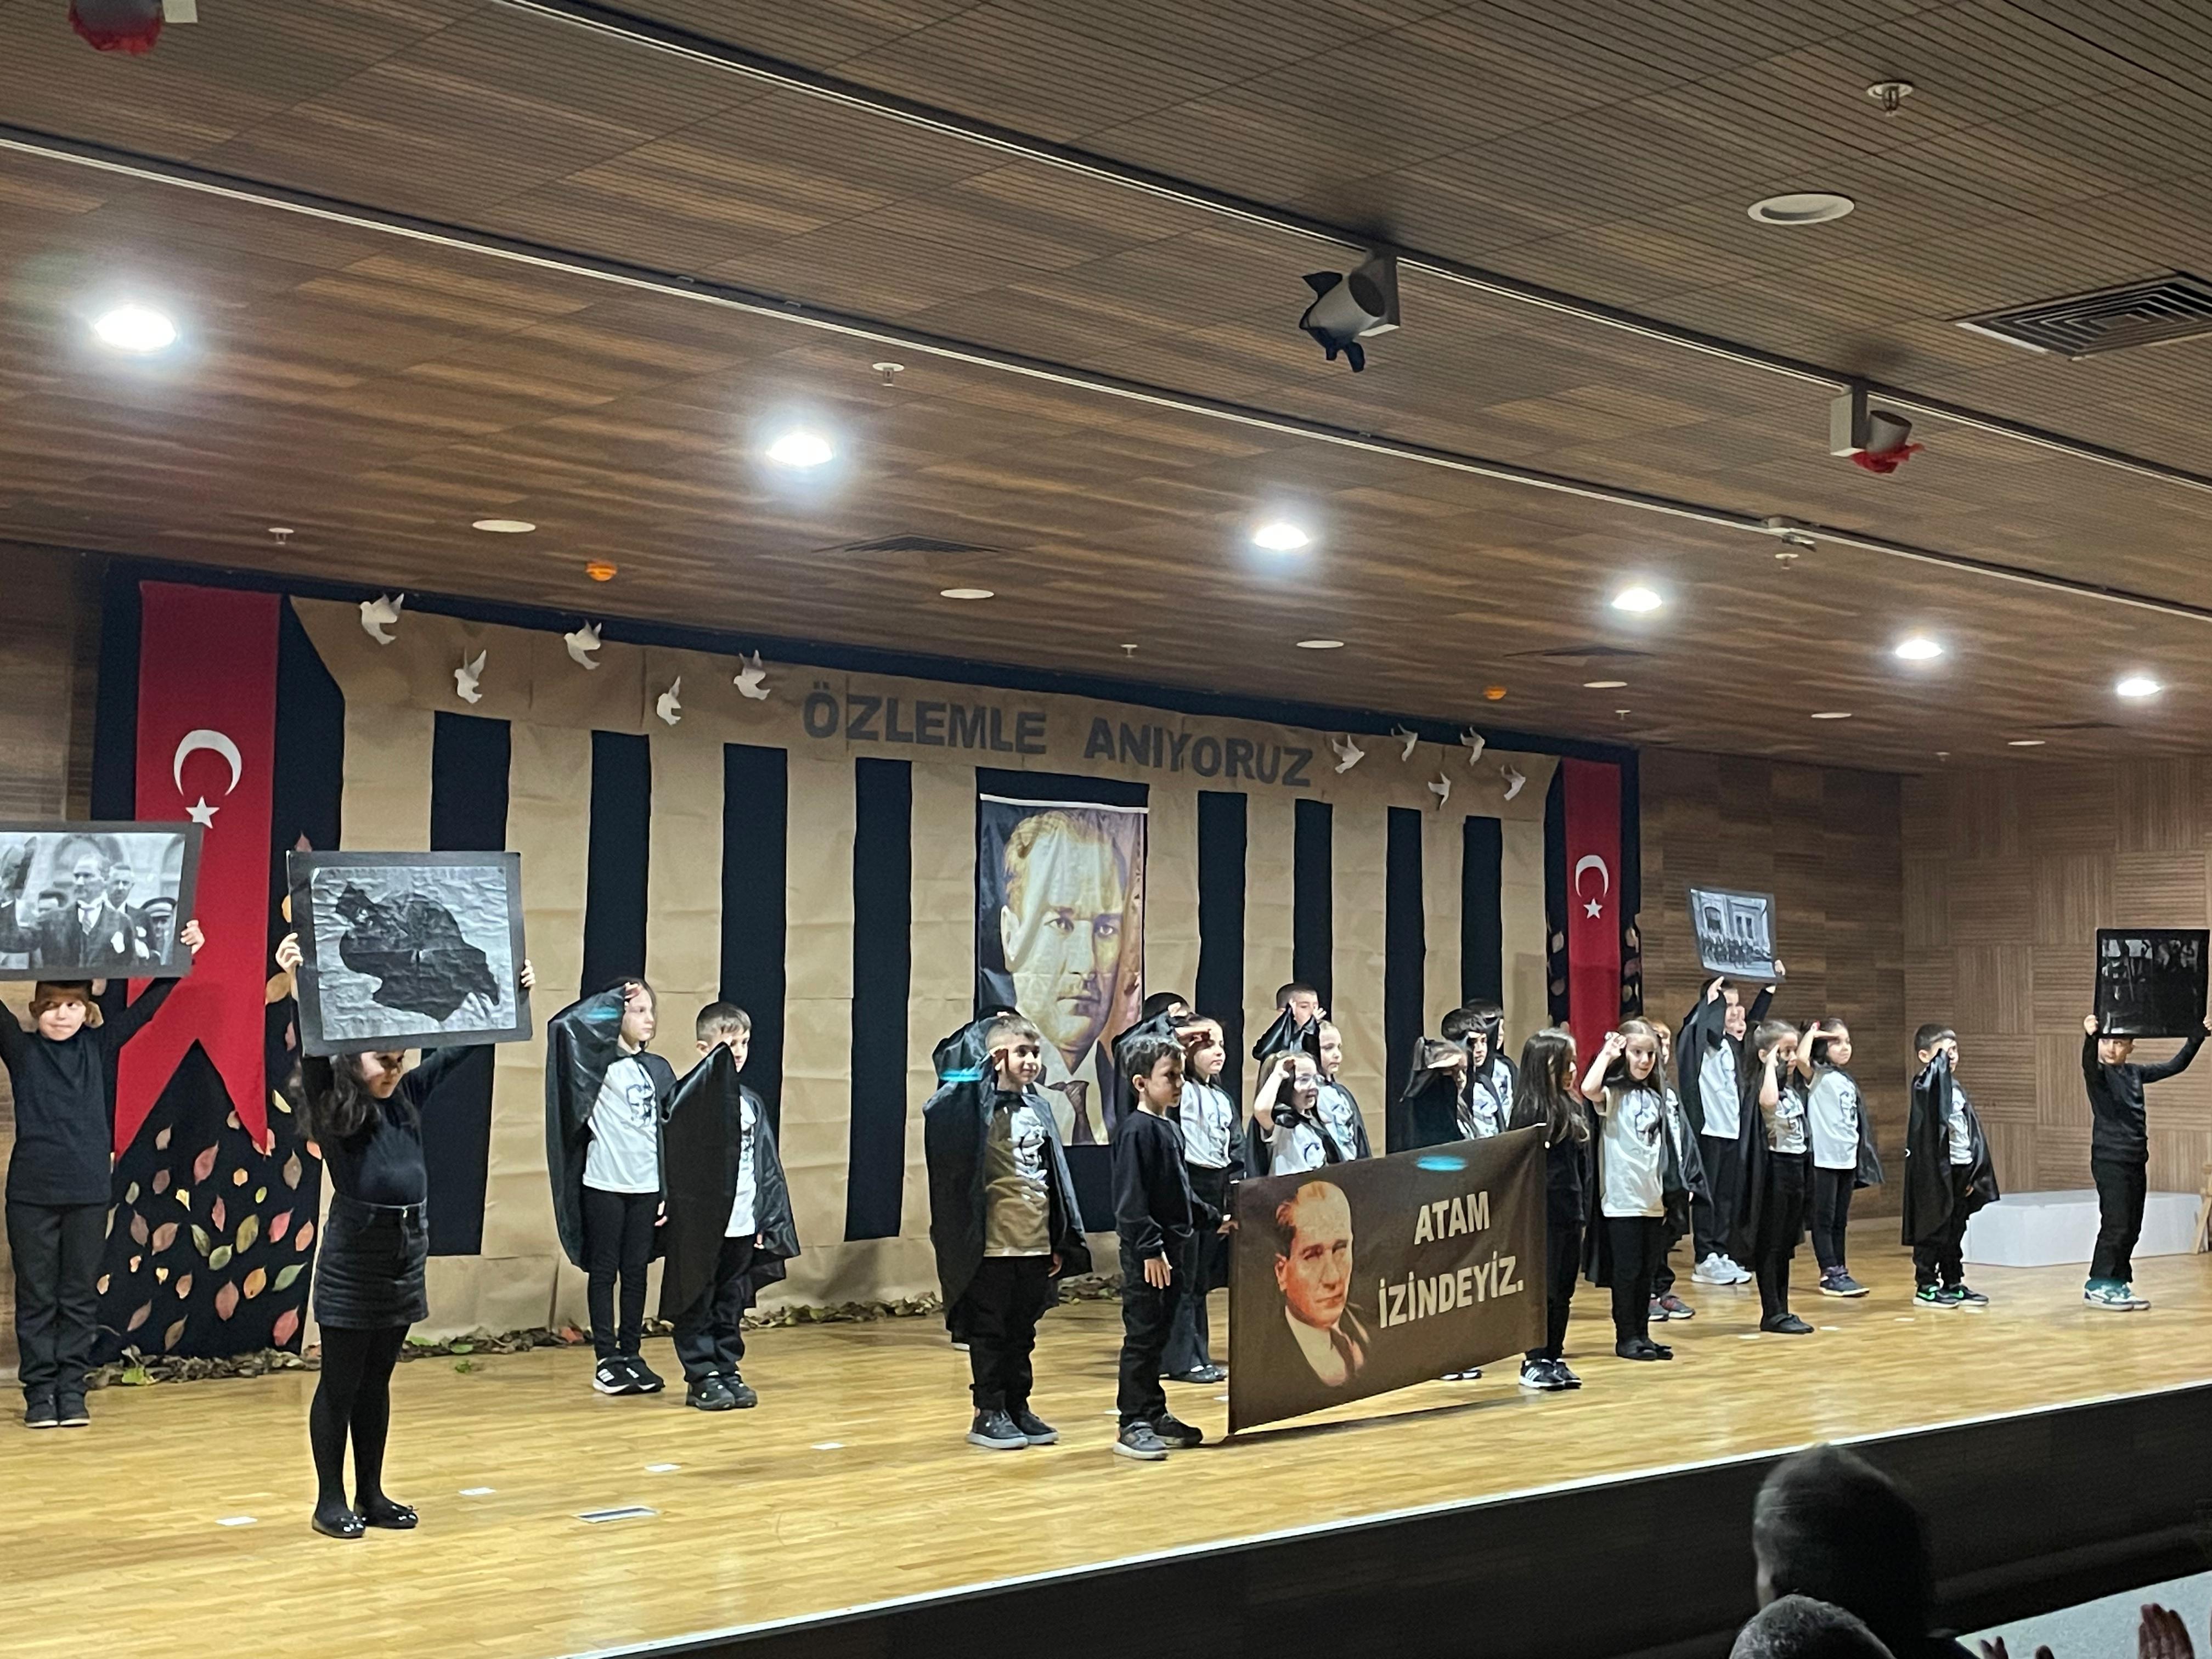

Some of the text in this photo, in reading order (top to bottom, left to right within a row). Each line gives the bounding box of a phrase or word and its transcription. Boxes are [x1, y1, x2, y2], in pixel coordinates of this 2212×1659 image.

[804, 682, 1313, 787] ÖZLEMLE ANIYORUZ
[1414, 1191, 1491, 1245] ATAM
[1379, 1251, 1523, 1328] İZİNDEYİZ.
